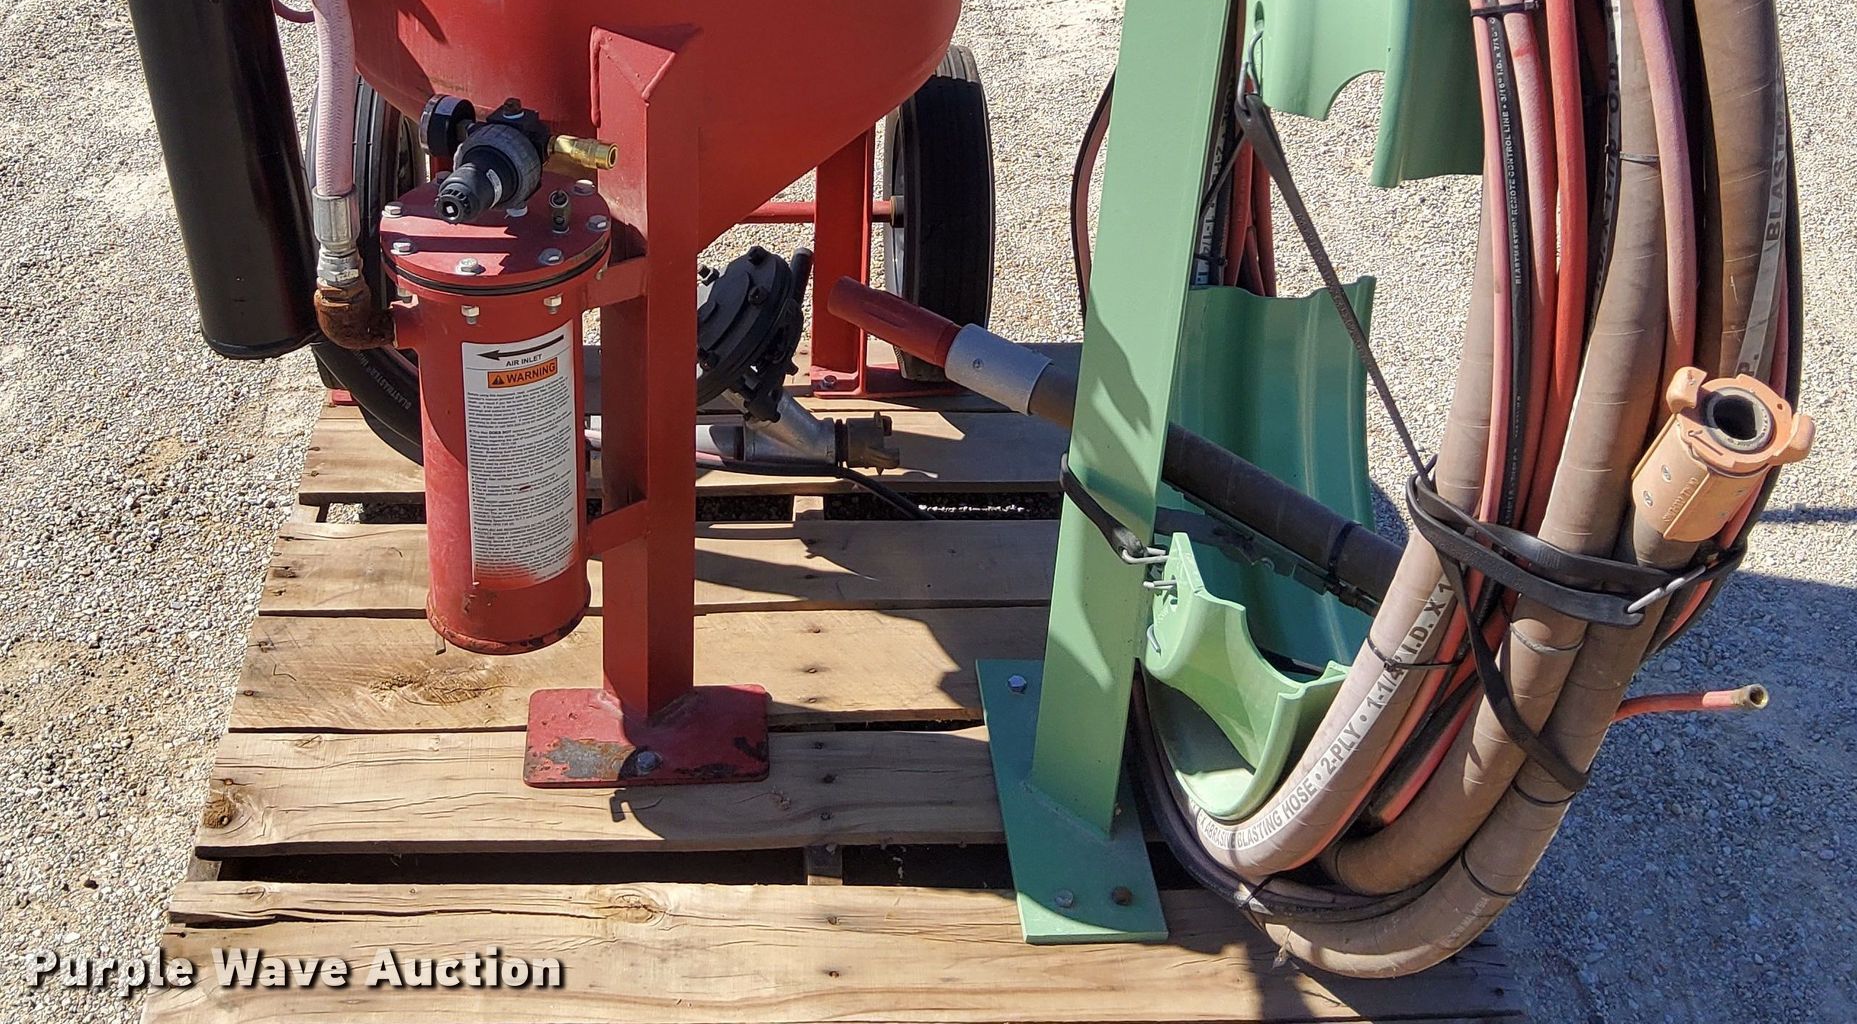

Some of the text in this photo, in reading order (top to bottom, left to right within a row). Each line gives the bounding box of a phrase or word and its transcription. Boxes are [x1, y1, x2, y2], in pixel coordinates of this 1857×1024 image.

[1502, 111, 1510, 133] LINE
[1504, 134, 1515, 177] CONTROL
[506, 354, 543, 367] AIR INLET
[506, 362, 556, 384] WARNING
[1236, 813, 1284, 849] BLASTING
[1282, 780, 1318, 822] HOSE
[1320, 723, 1363, 775] 2-PLY
[1402, 622, 1434, 655] I.D.
